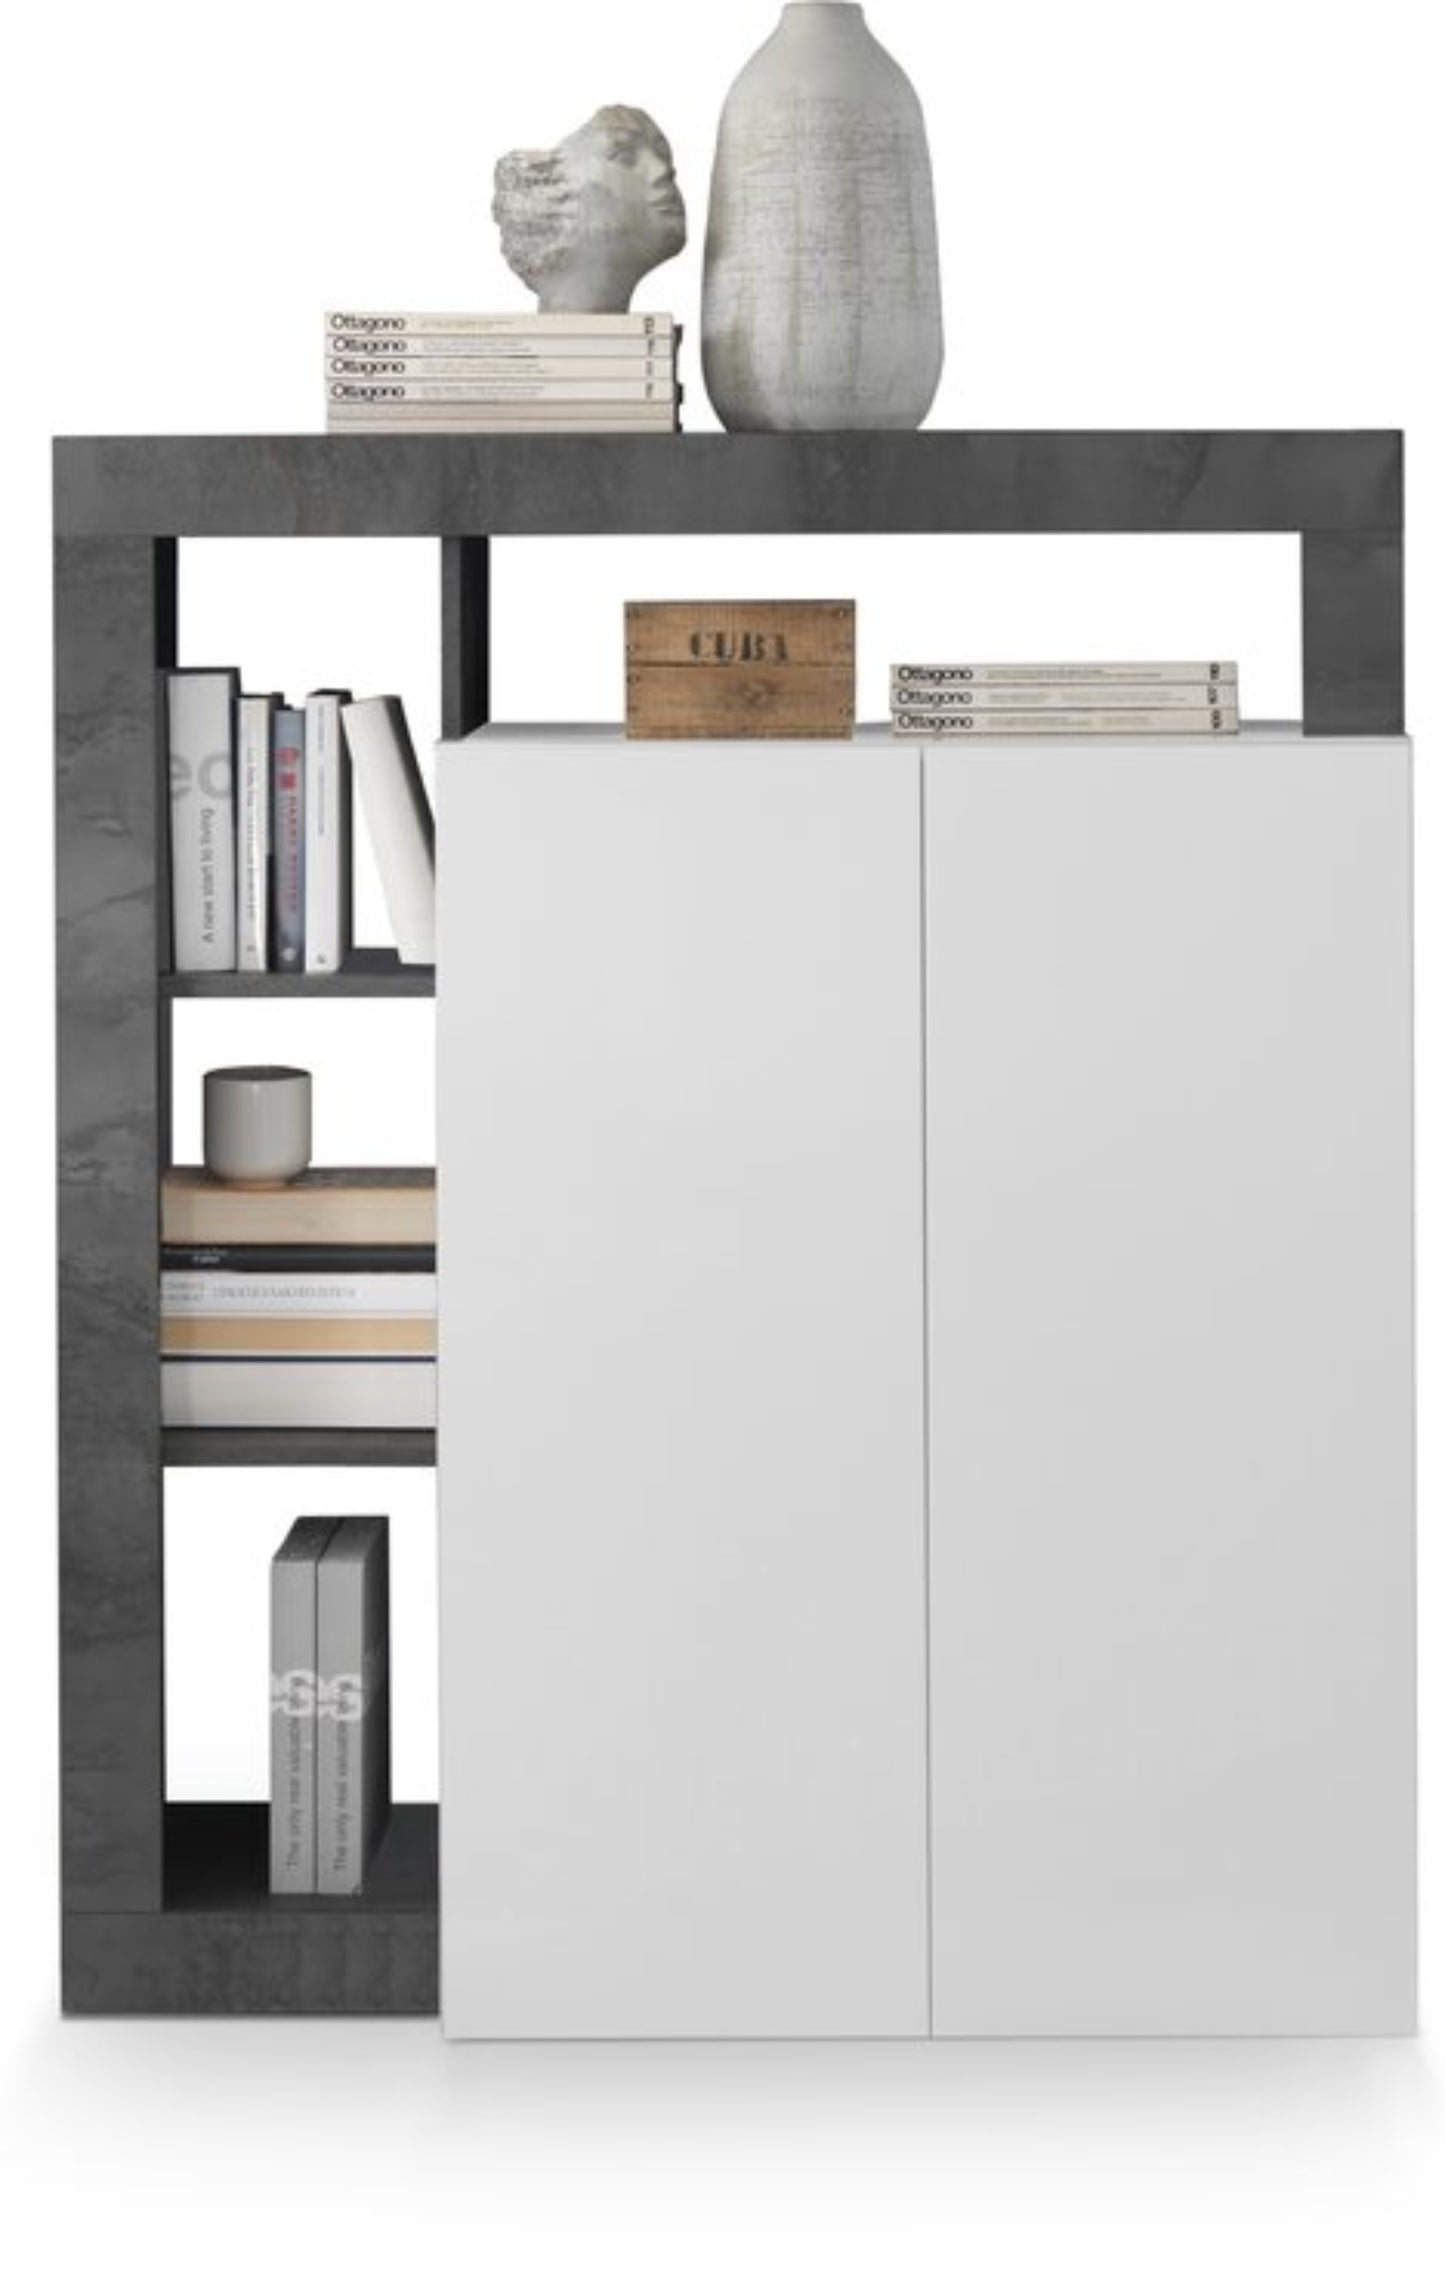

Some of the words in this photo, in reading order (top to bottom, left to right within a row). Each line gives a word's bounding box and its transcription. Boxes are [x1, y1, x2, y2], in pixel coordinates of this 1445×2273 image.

[330, 312, 406, 334] Ottagono
[332, 335, 408, 355] Ottagono
[330, 357, 406, 377] Ottagono
[330, 382, 406, 402] Ottagono
[898, 666, 974, 686] Ottagono
[898, 688, 974, 709] Ottagono
[898, 712, 974, 733] Ottagono
[202, 901, 214, 930] new
[200, 932, 214, 943] A
[332, 1847, 347, 1872] The
